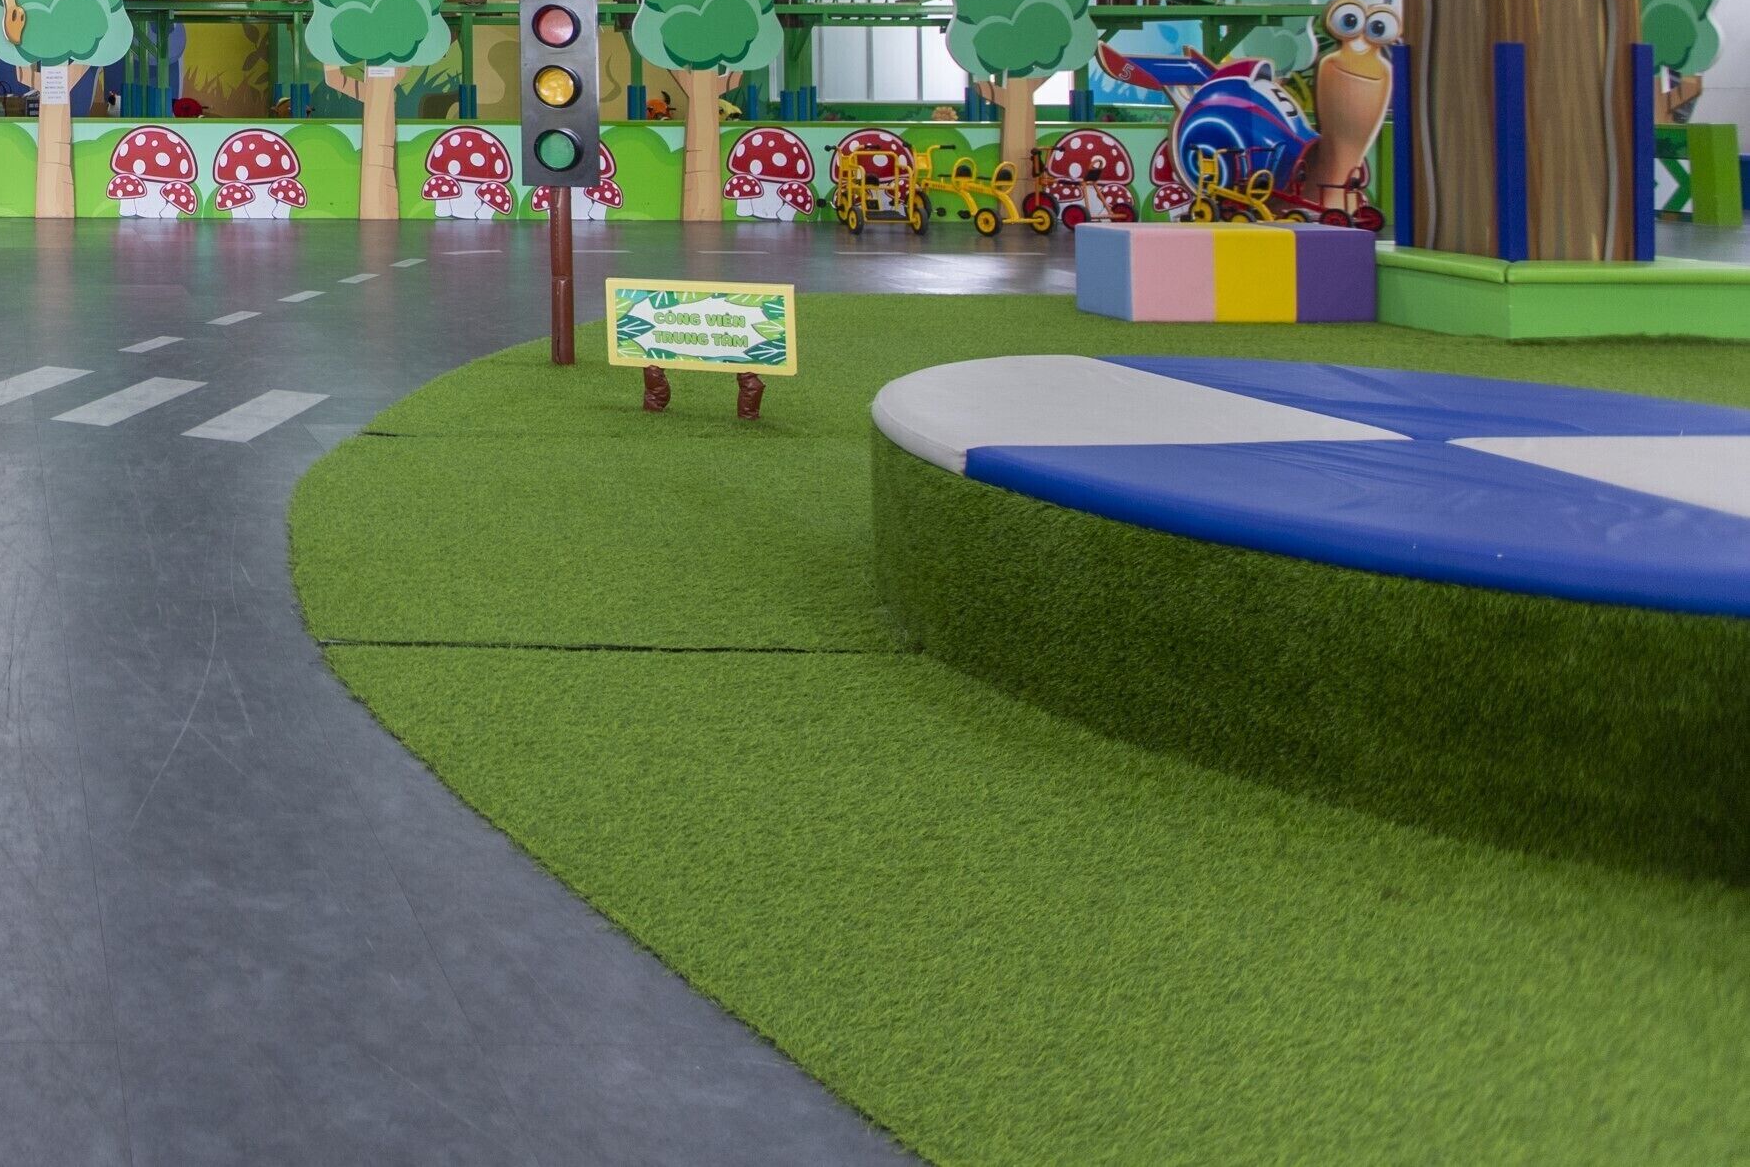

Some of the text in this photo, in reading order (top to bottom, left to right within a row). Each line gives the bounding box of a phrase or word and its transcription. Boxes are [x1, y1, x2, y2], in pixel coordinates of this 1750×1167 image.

[1118, 63, 1135, 81] 5
[1270, 87, 1299, 118] 5
[653, 310, 746, 328] CÔNG VIÊN
[652, 331, 709, 346] TRUNG
